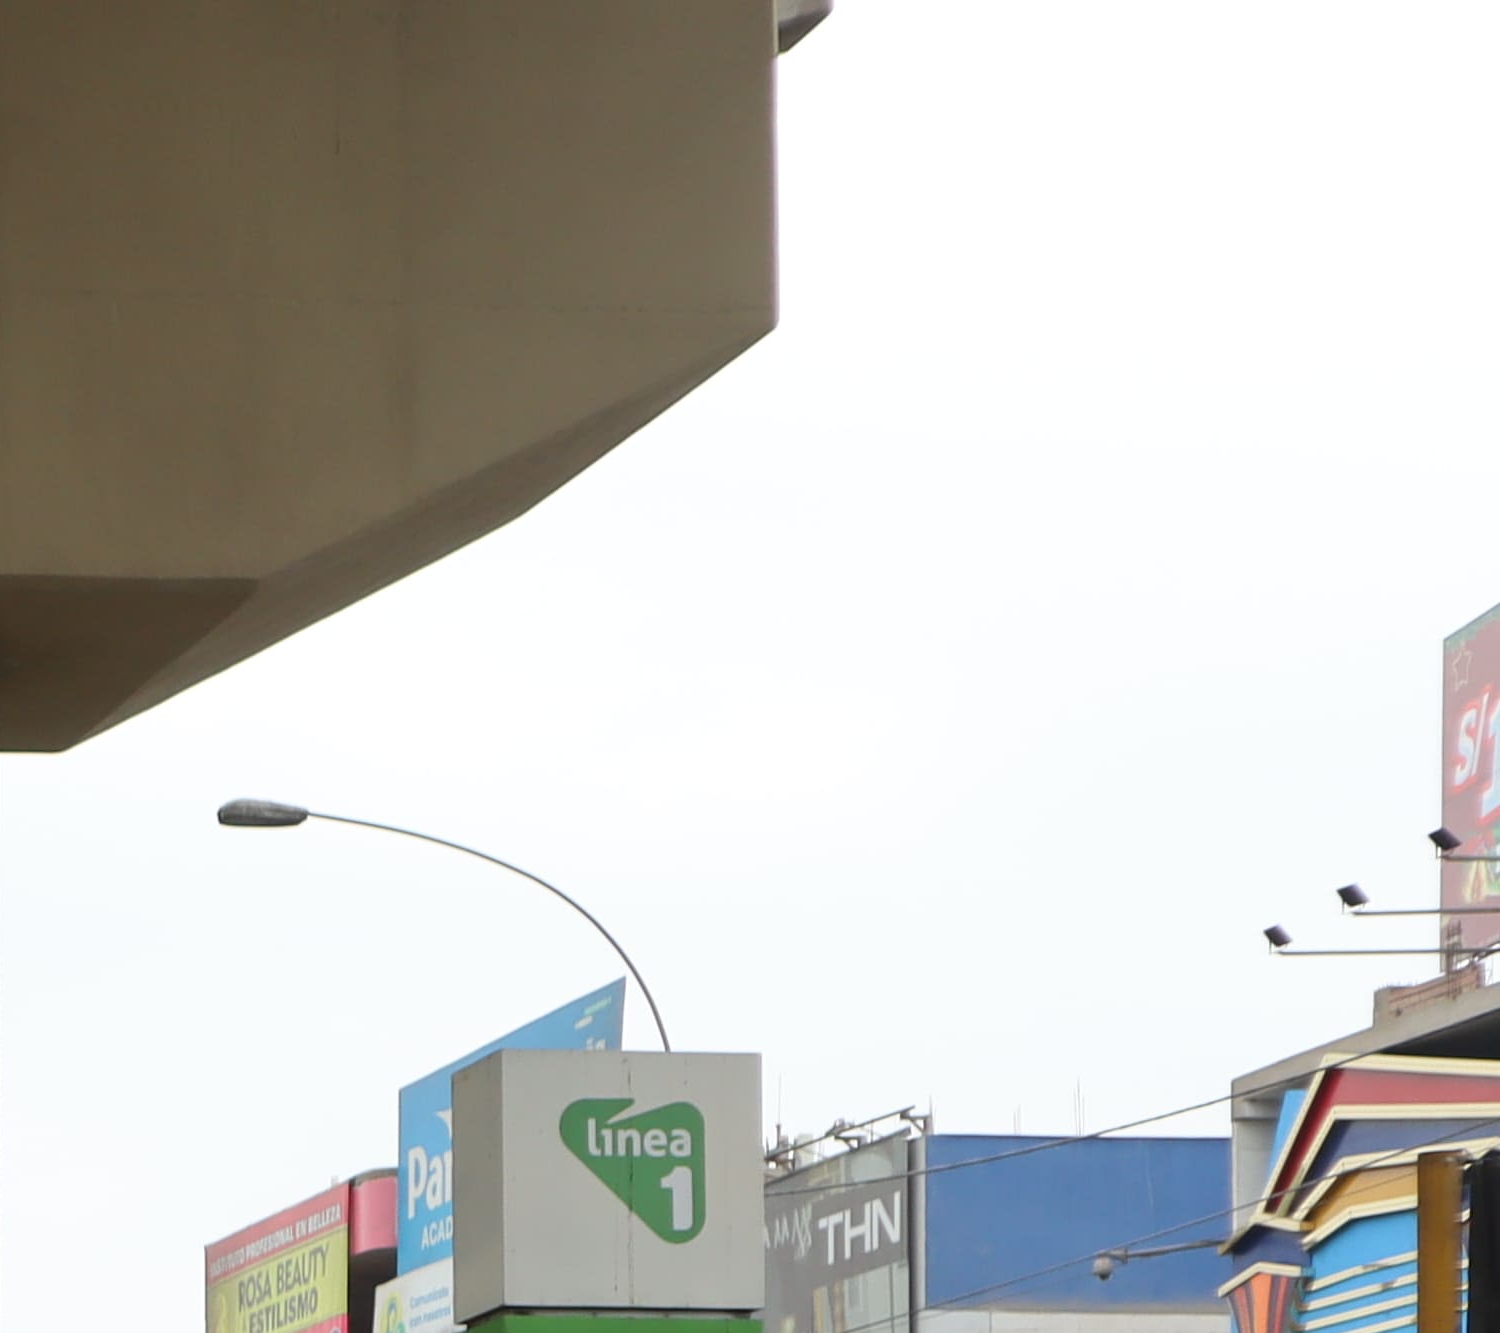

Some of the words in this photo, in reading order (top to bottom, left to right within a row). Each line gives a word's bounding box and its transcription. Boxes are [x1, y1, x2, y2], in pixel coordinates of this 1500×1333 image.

[588, 1117, 692, 1158] línea
[295, 1220, 307, 1239] EN
[308, 1204, 341, 1234] BELLEZA
[661, 1165, 693, 1231] 1
[818, 1190, 901, 1267] THN
[238, 1268, 272, 1312] ROSA
[276, 1243, 330, 1294] BEAUTY
